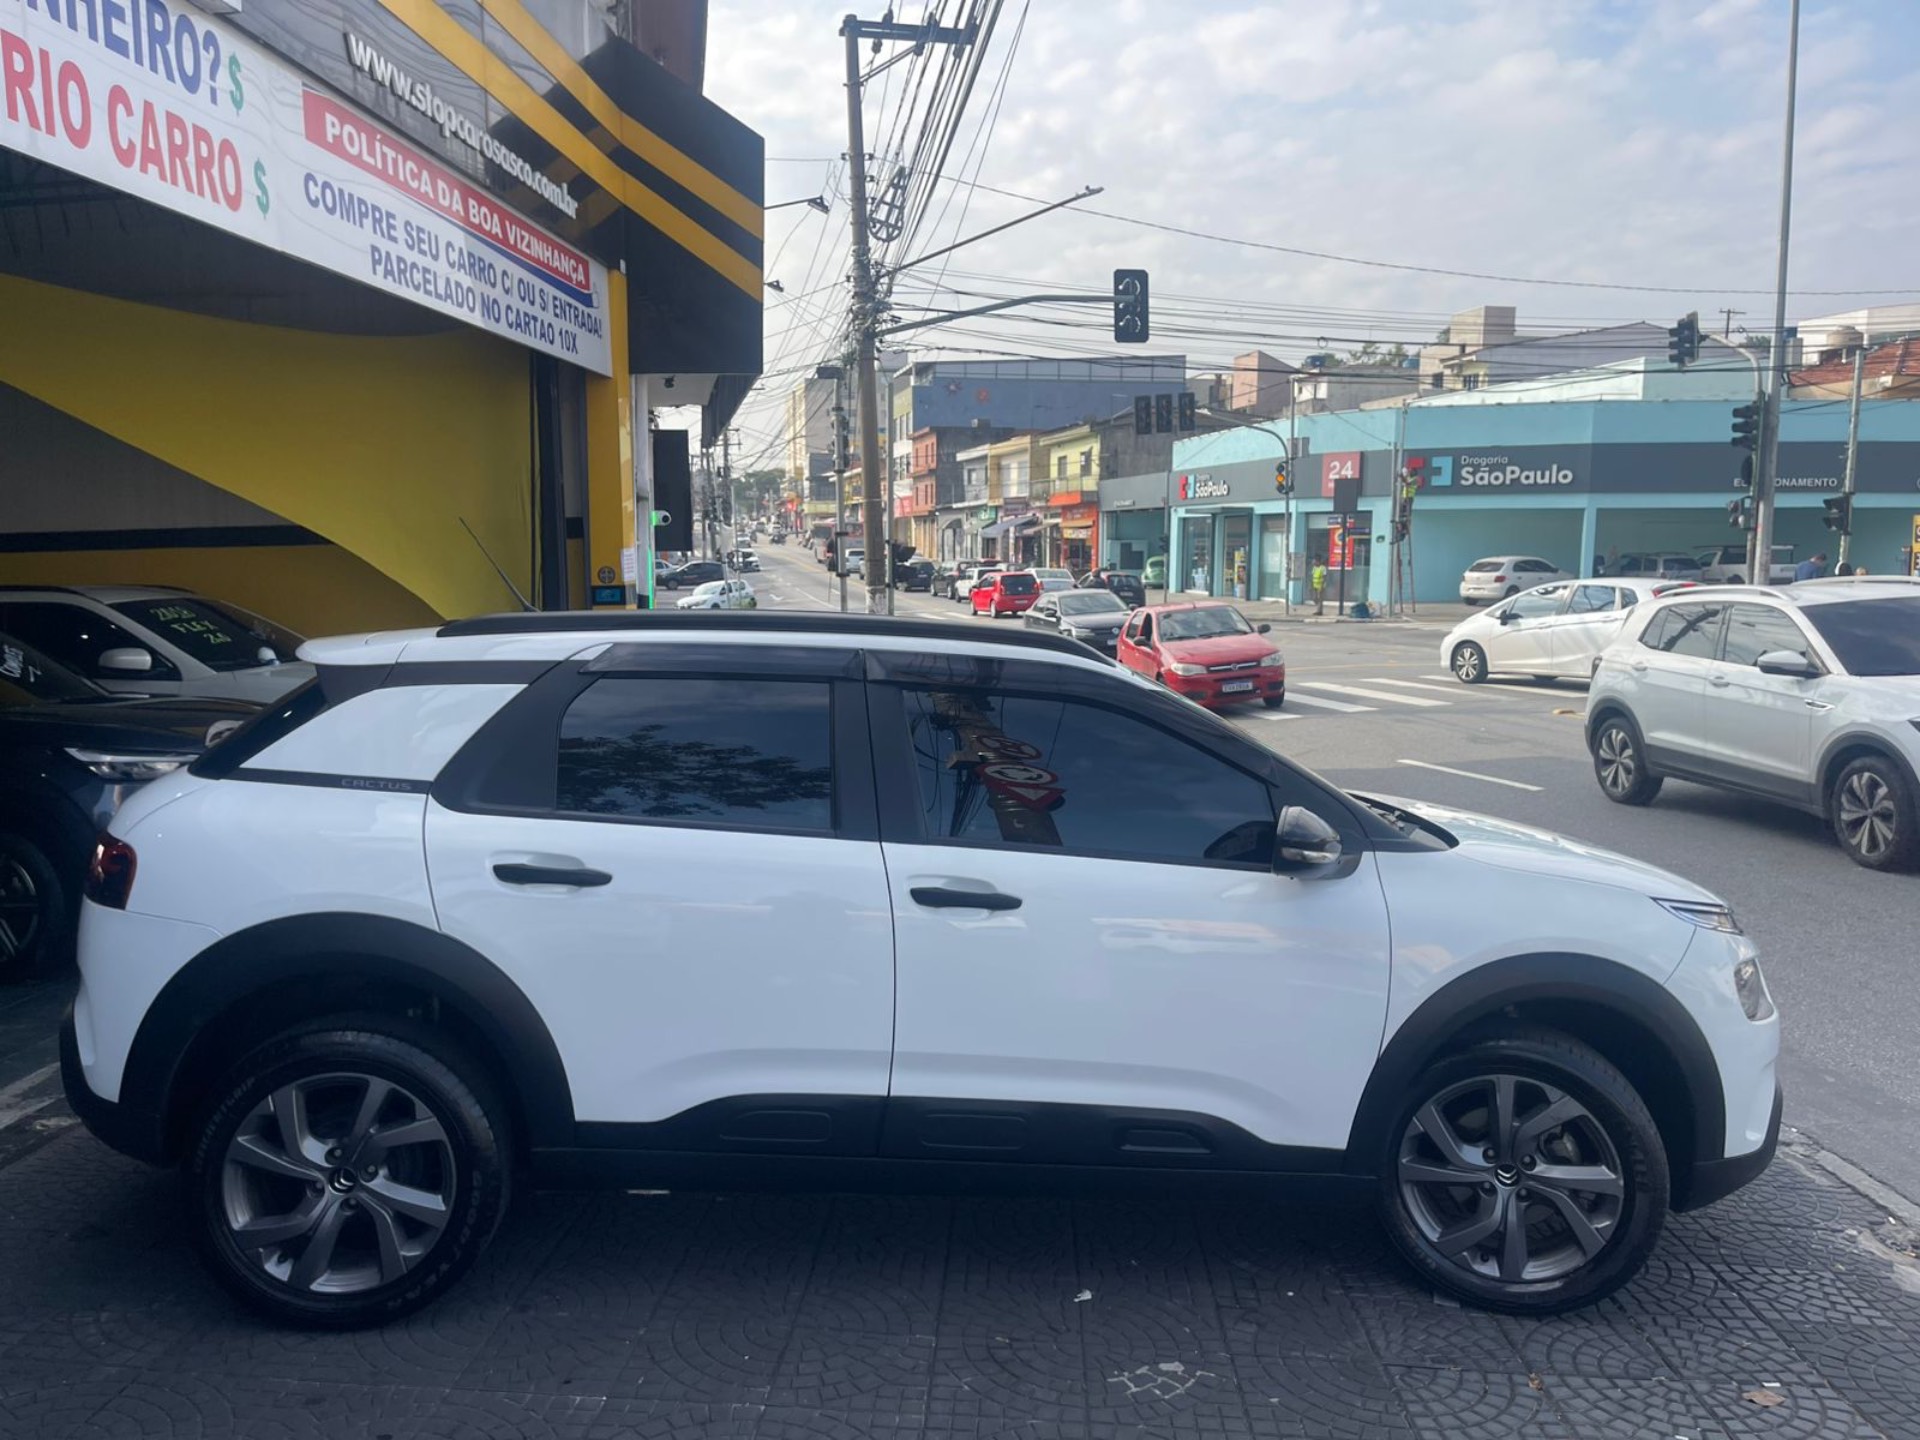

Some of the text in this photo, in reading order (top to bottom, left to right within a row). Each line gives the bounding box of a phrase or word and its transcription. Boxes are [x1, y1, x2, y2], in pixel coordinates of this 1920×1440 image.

[0, 27, 91, 149] RIO
[107, 84, 243, 213] CARRO
[325, 111, 586, 286] POLÍTICA DA BOA VIZINHANÇA
[304, 171, 399, 245] COMPRE
[404, 219, 440, 263] SEU
[445, 240, 497, 290] CARRO
[517, 277, 535, 307] OU
[552, 294, 602, 339] ENTRADA!
[370, 243, 476, 314] PARCELADO
[480, 291, 501, 324] NO
[559, 327, 578, 355] 10X
[1328, 460, 1354, 479] 24
[1460, 455, 1508, 466] Drogaria
[1460, 464, 1573, 486] SãoPaulo
[341, 778, 412, 791] CACTUS
